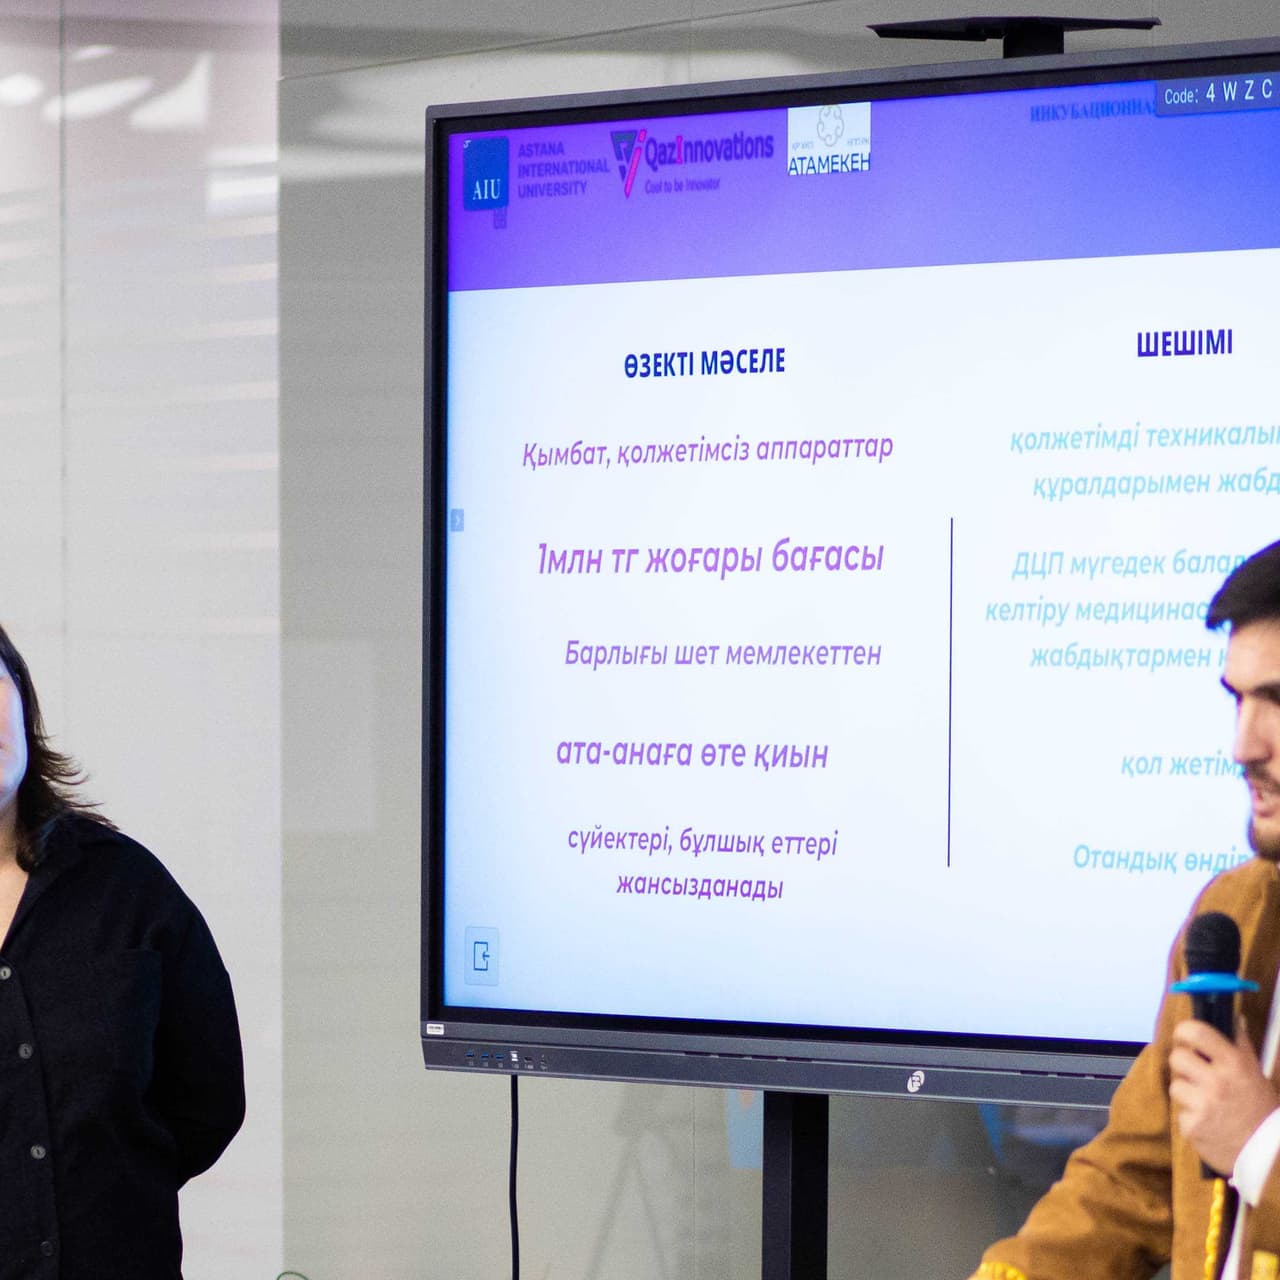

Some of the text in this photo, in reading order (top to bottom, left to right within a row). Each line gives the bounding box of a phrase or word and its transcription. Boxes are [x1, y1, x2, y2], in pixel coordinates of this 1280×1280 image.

[1031, 98, 1157, 122] ИНКУБАЦИОННА
[1165, 88, 1199, 105] Code:
[518, 141, 564, 158] ASTANA
[645, 132, 774, 172] QazInnovations
[517, 158, 611, 178] INTERNATIONAL
[472, 178, 501, 200] AIU
[518, 180, 587, 199] UNIVERSITY
[1137, 329, 1234, 357] ШЕШІМІ
[624, 347, 786, 378] ӨЗЕКТІ МӘСЕЛЕ
[523, 434, 894, 469] Қымбат, қолжетімсіз аппараттар
[1011, 422, 1141, 454] қолжетімді
[1033, 472, 1210, 502] құралдарымен
[538, 537, 885, 580] 1млн тг жоғары бағасы
[1011, 551, 1064, 580] ДЦП
[1069, 555, 1167, 580] мүгедек
[985, 595, 1070, 627] келтіру
[565, 640, 883, 671] Барлығы шет мемлекеттен
[1029, 641, 1211, 673] жабдықтармен
[556, 740, 829, 772] ата-анаға өте қиын
[1121, 749, 1243, 780] қол жетім
[568, 825, 839, 861] сүйектері, бұлшық еттері
[1073, 844, 1177, 875] Отандық
[616, 873, 784, 902] жансызданады
